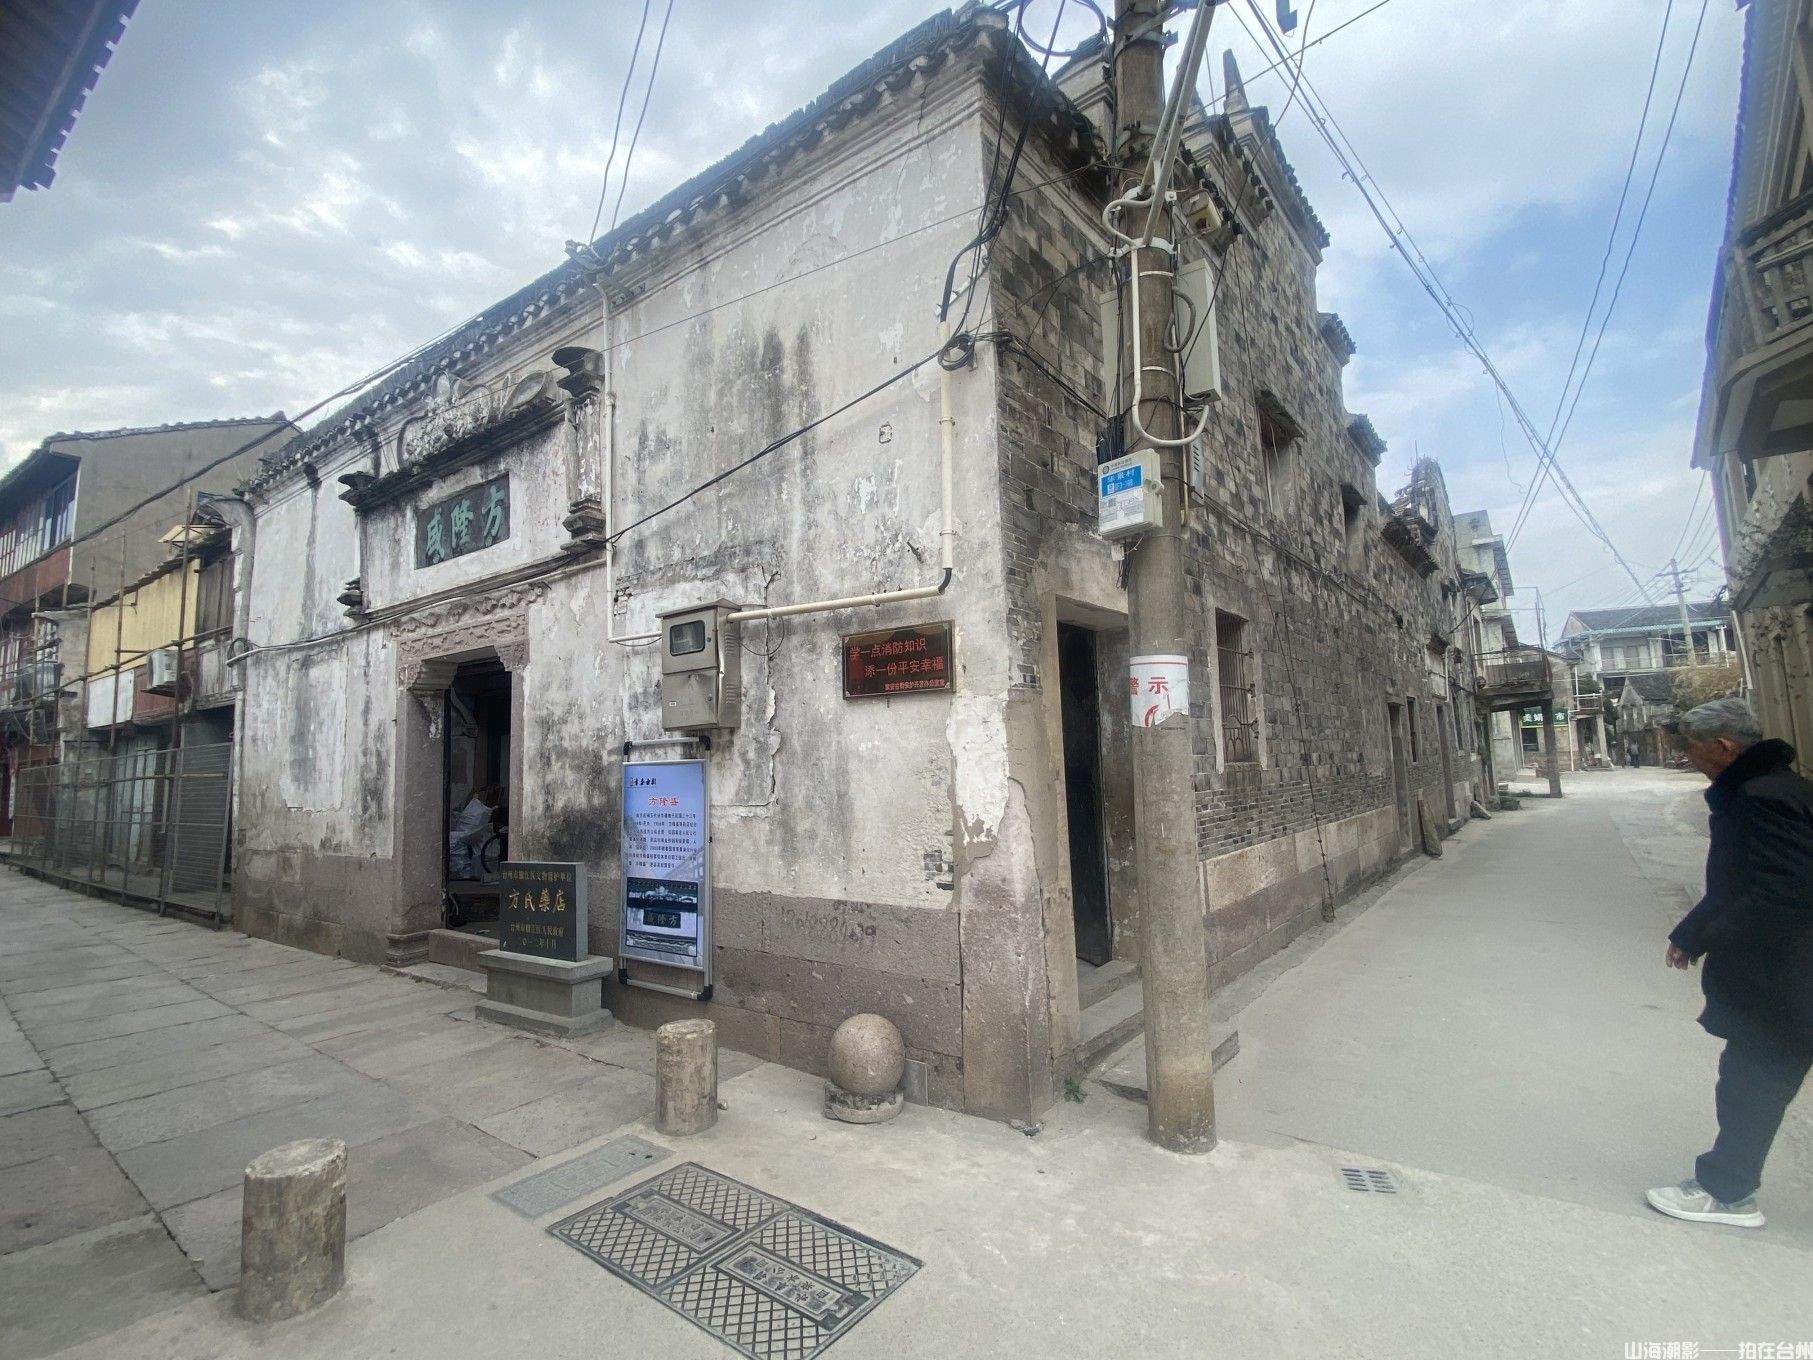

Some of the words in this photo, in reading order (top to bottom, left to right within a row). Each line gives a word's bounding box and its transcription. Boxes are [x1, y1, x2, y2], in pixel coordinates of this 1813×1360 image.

[850, 637, 927, 660] 学一点消防知识
[865, 656, 944, 677] 添一份平安幸福
